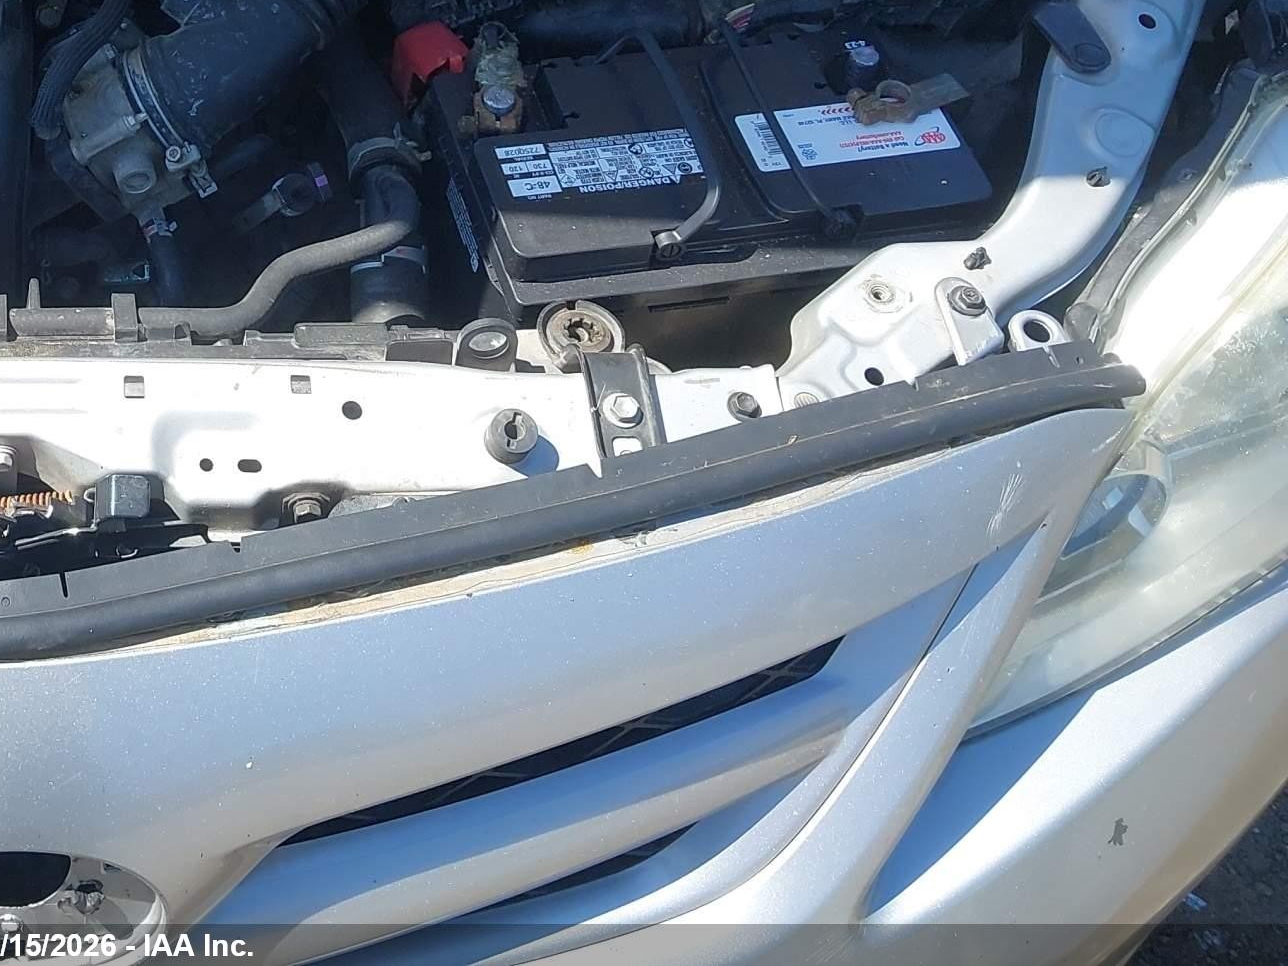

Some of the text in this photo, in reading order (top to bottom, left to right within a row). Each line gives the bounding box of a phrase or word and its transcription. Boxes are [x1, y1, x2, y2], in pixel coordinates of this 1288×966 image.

[922, 132, 945, 143] AAA
[524, 181, 551, 191] 48-C
[578, 177, 670, 194] DANGER/POISON
